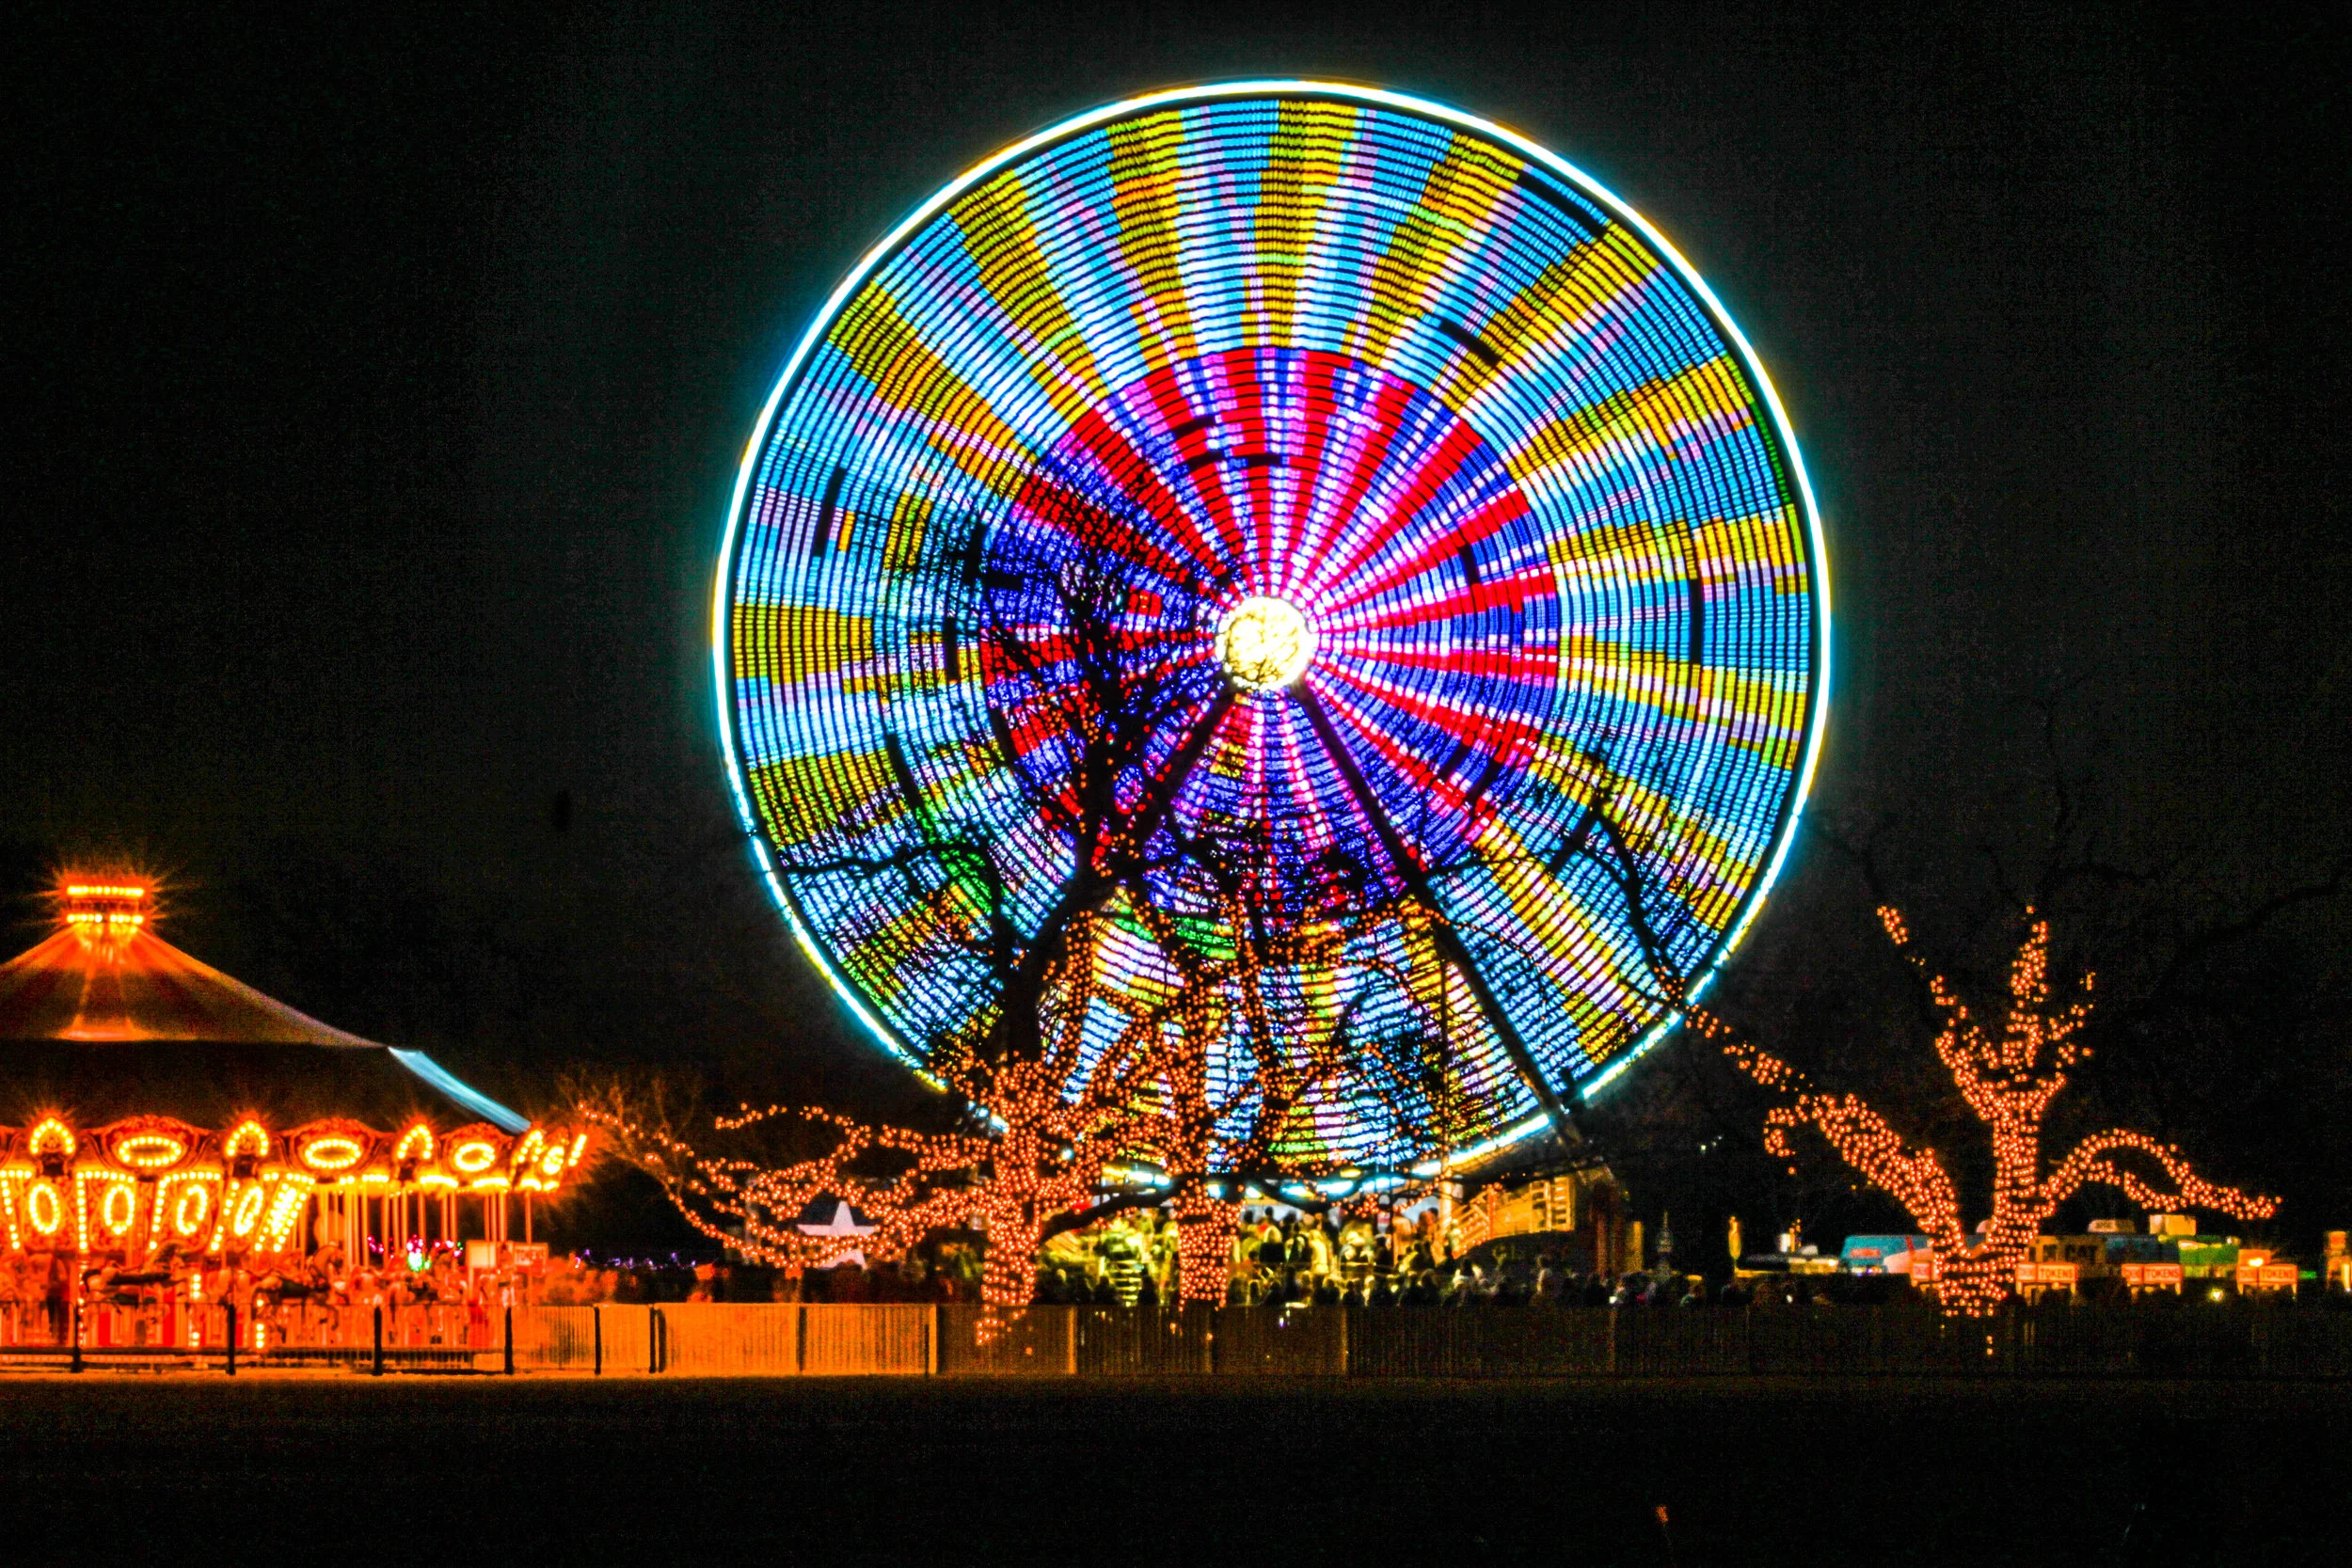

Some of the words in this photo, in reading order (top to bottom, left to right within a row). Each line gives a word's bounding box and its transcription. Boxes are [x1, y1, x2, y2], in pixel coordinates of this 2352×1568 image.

[2041, 1268, 2074, 1278] TOKENS
[2145, 1268, 2180, 1278] TOKENS
[2261, 1268, 2295, 1279] TOKENS
